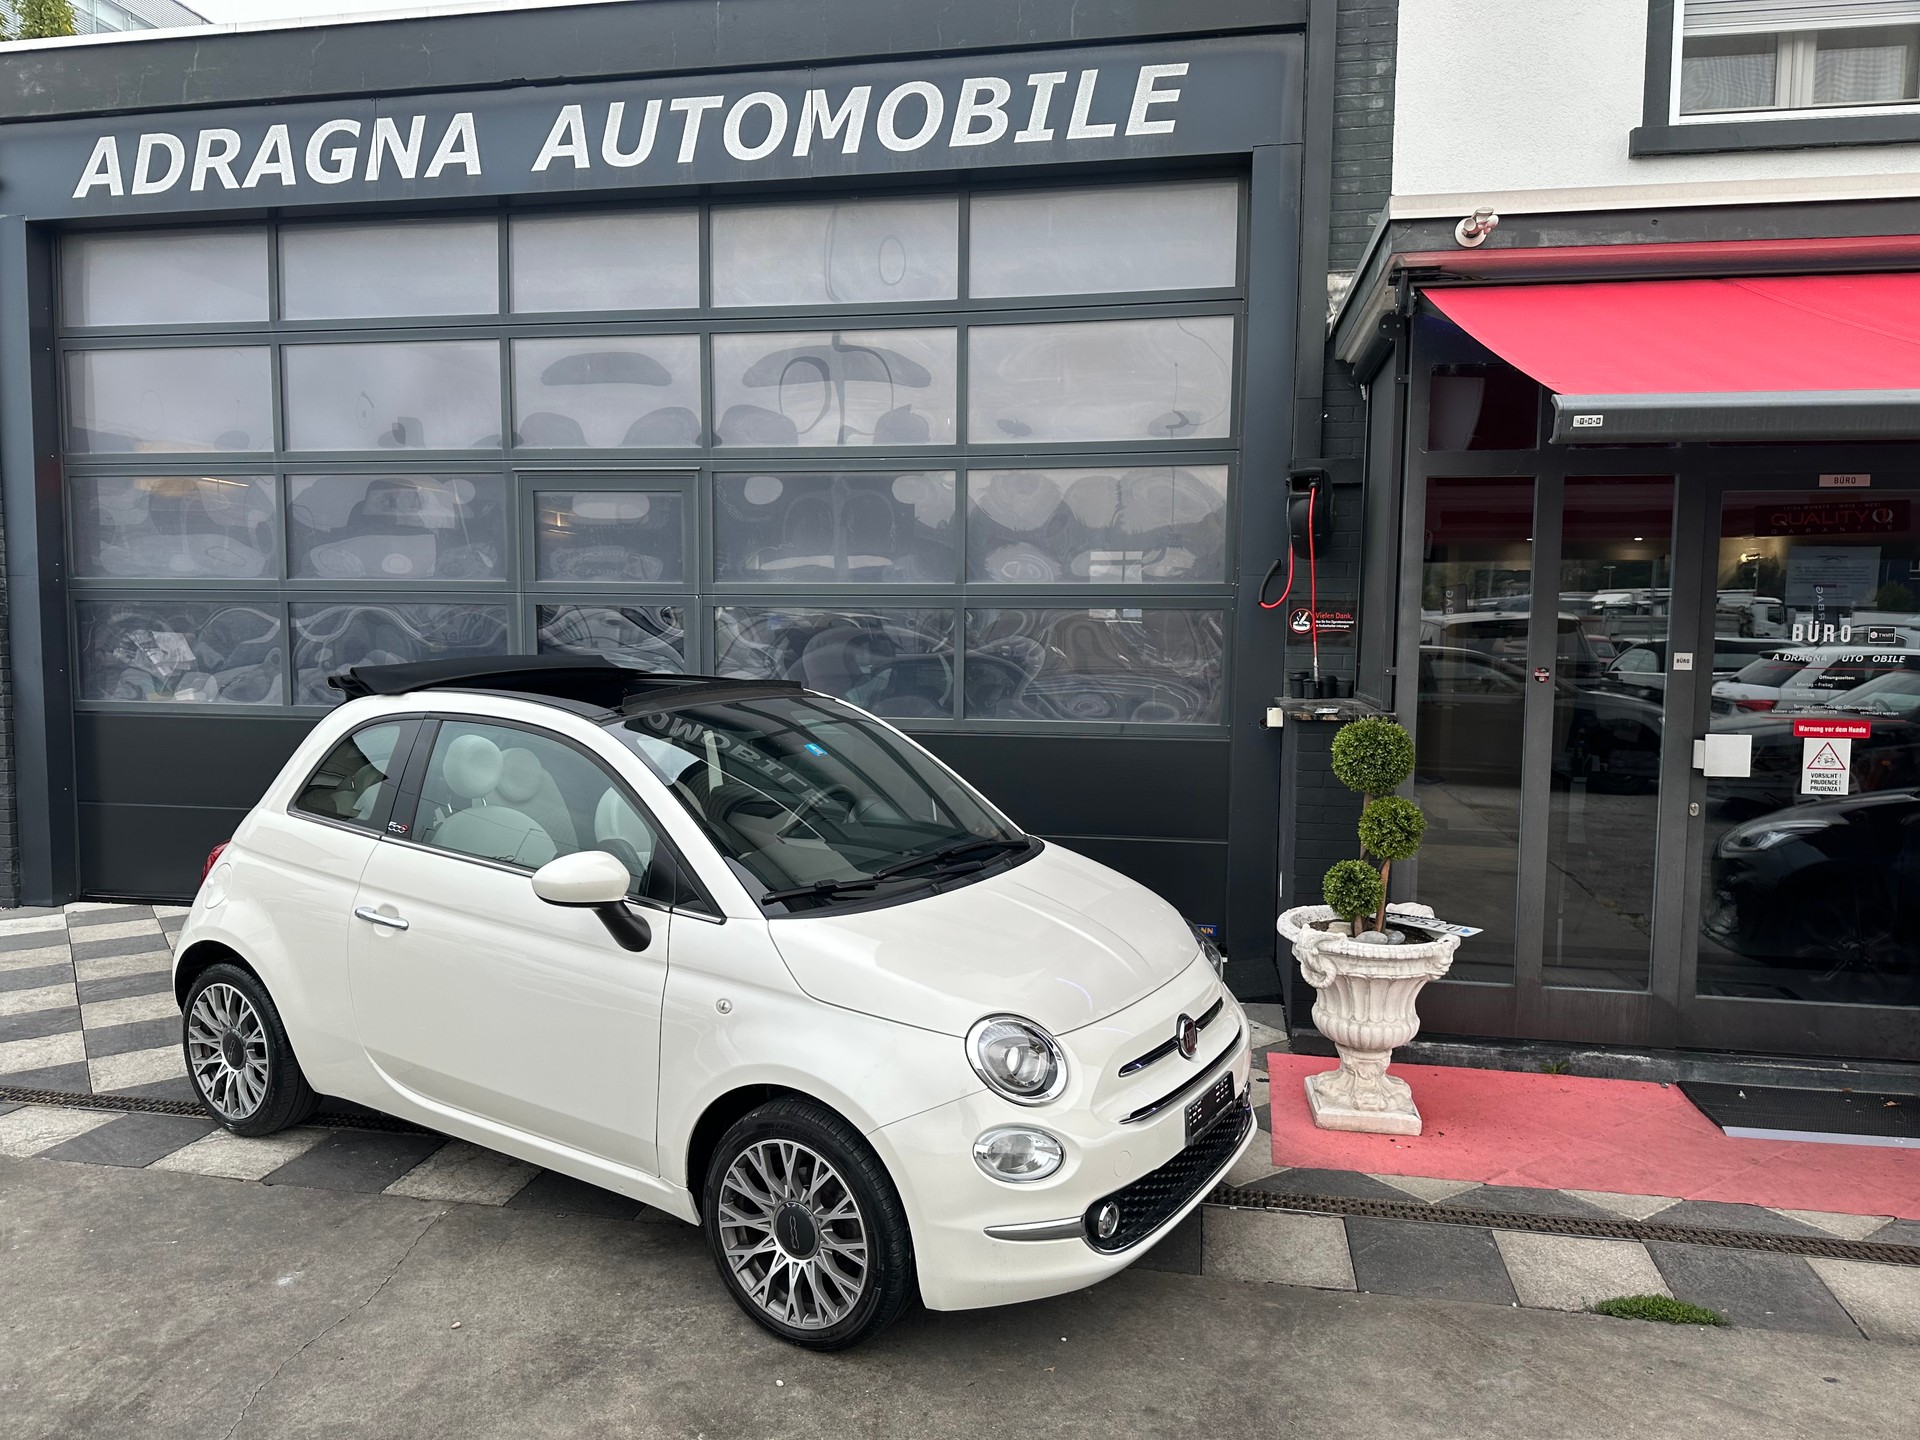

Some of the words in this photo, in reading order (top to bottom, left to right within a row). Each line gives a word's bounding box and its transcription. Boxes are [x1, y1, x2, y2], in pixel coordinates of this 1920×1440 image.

[72, 113, 482, 199] ADRAGNA
[531, 63, 1190, 172] AUTOMOBILE
[1834, 476, 1857, 484] BÜRO
[1770, 510, 1869, 527] QUALITY
[1792, 621, 1852, 643] BÜRO
[1798, 725, 1824, 734] Warnung
[1848, 726, 1867, 734] Hunde
